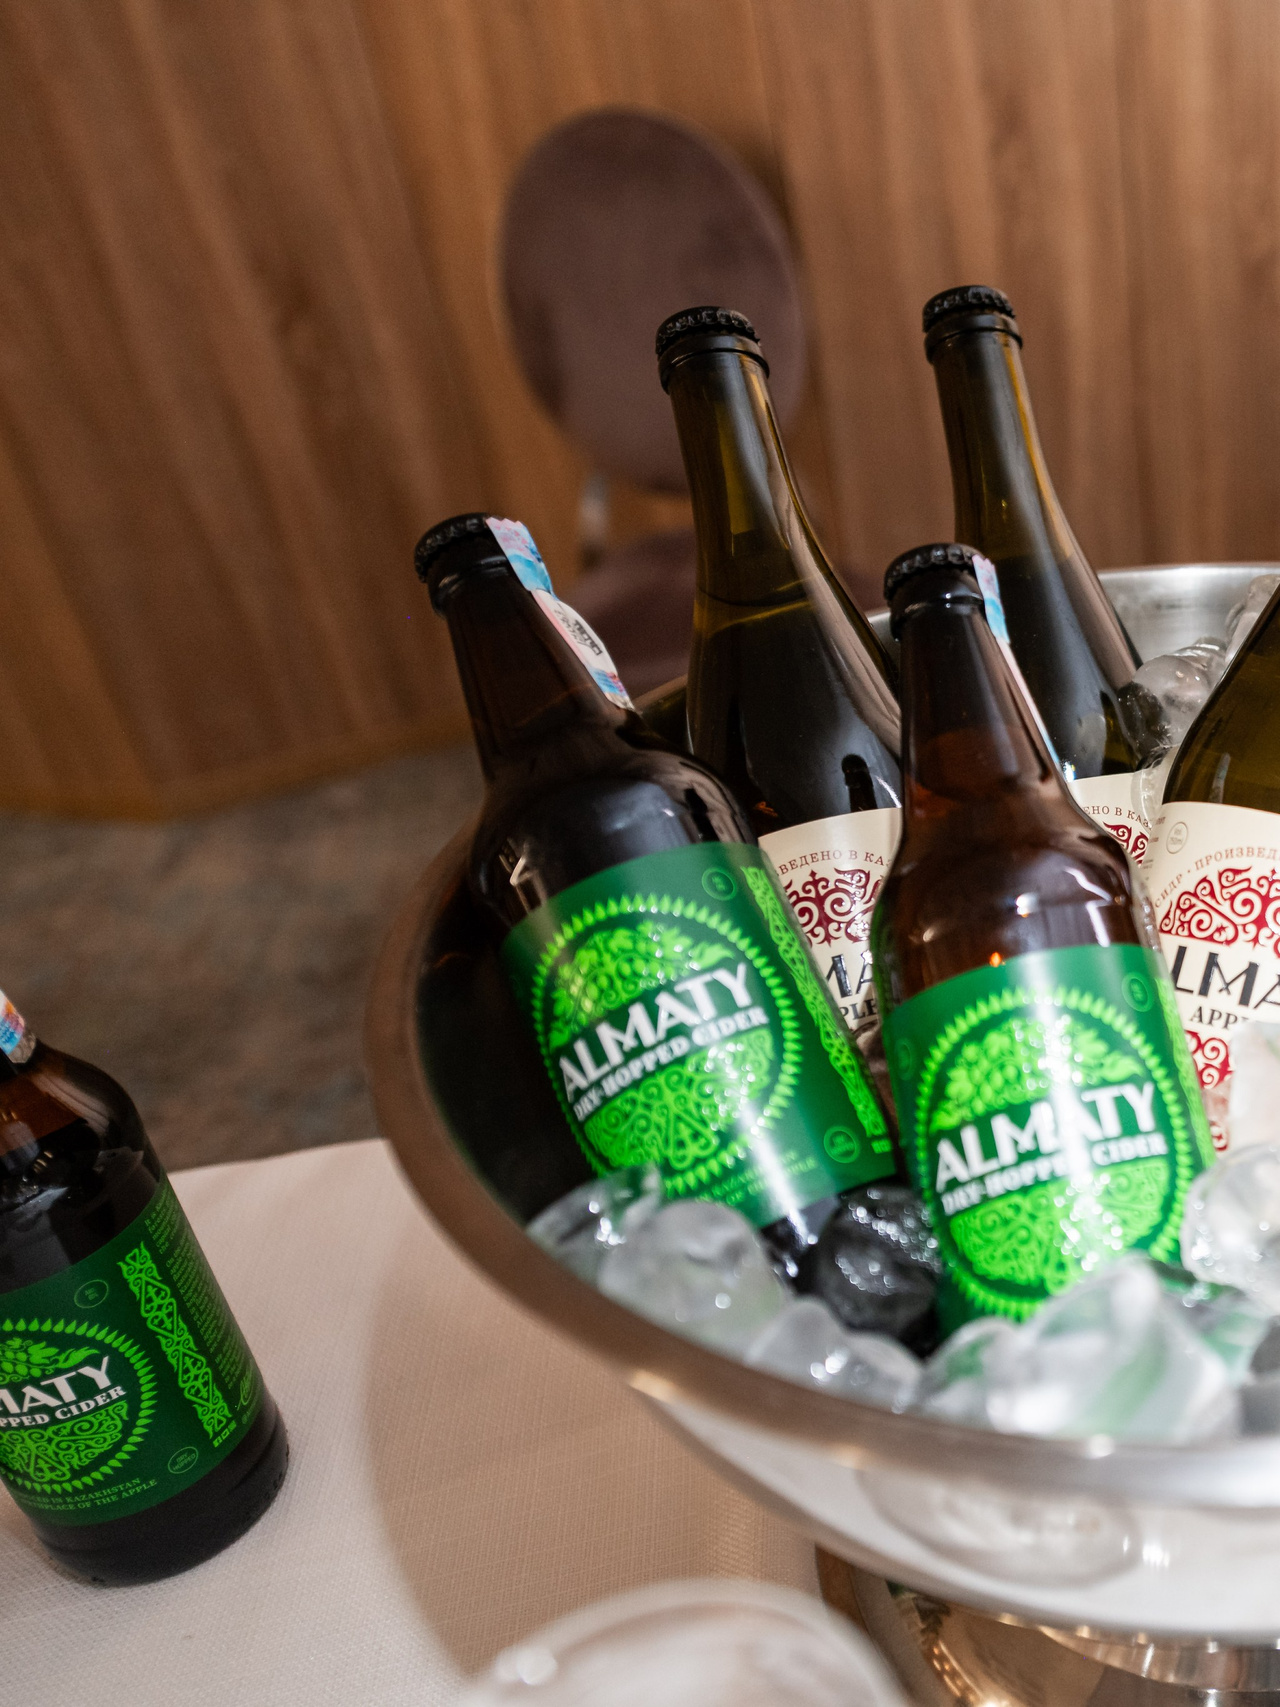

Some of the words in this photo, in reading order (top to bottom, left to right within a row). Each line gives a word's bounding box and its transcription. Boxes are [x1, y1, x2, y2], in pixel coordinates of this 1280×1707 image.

[776, 850, 843, 877] ВЕДЕНО
[558, 962, 753, 1104] ALMATY
[692, 1006, 770, 1047] CIDER
[1189, 1005, 1250, 1031] APP
[936, 1081, 1156, 1194] ALMATY
[1092, 1131, 1169, 1166] CIDER
[54, 1385, 128, 1421] CIDER
[66, 1478, 141, 1503] KAZAKHSTAN
[77, 1500, 92, 1509] OF
[95, 1495, 119, 1506] THE
[121, 1478, 158, 1499] APPLE
